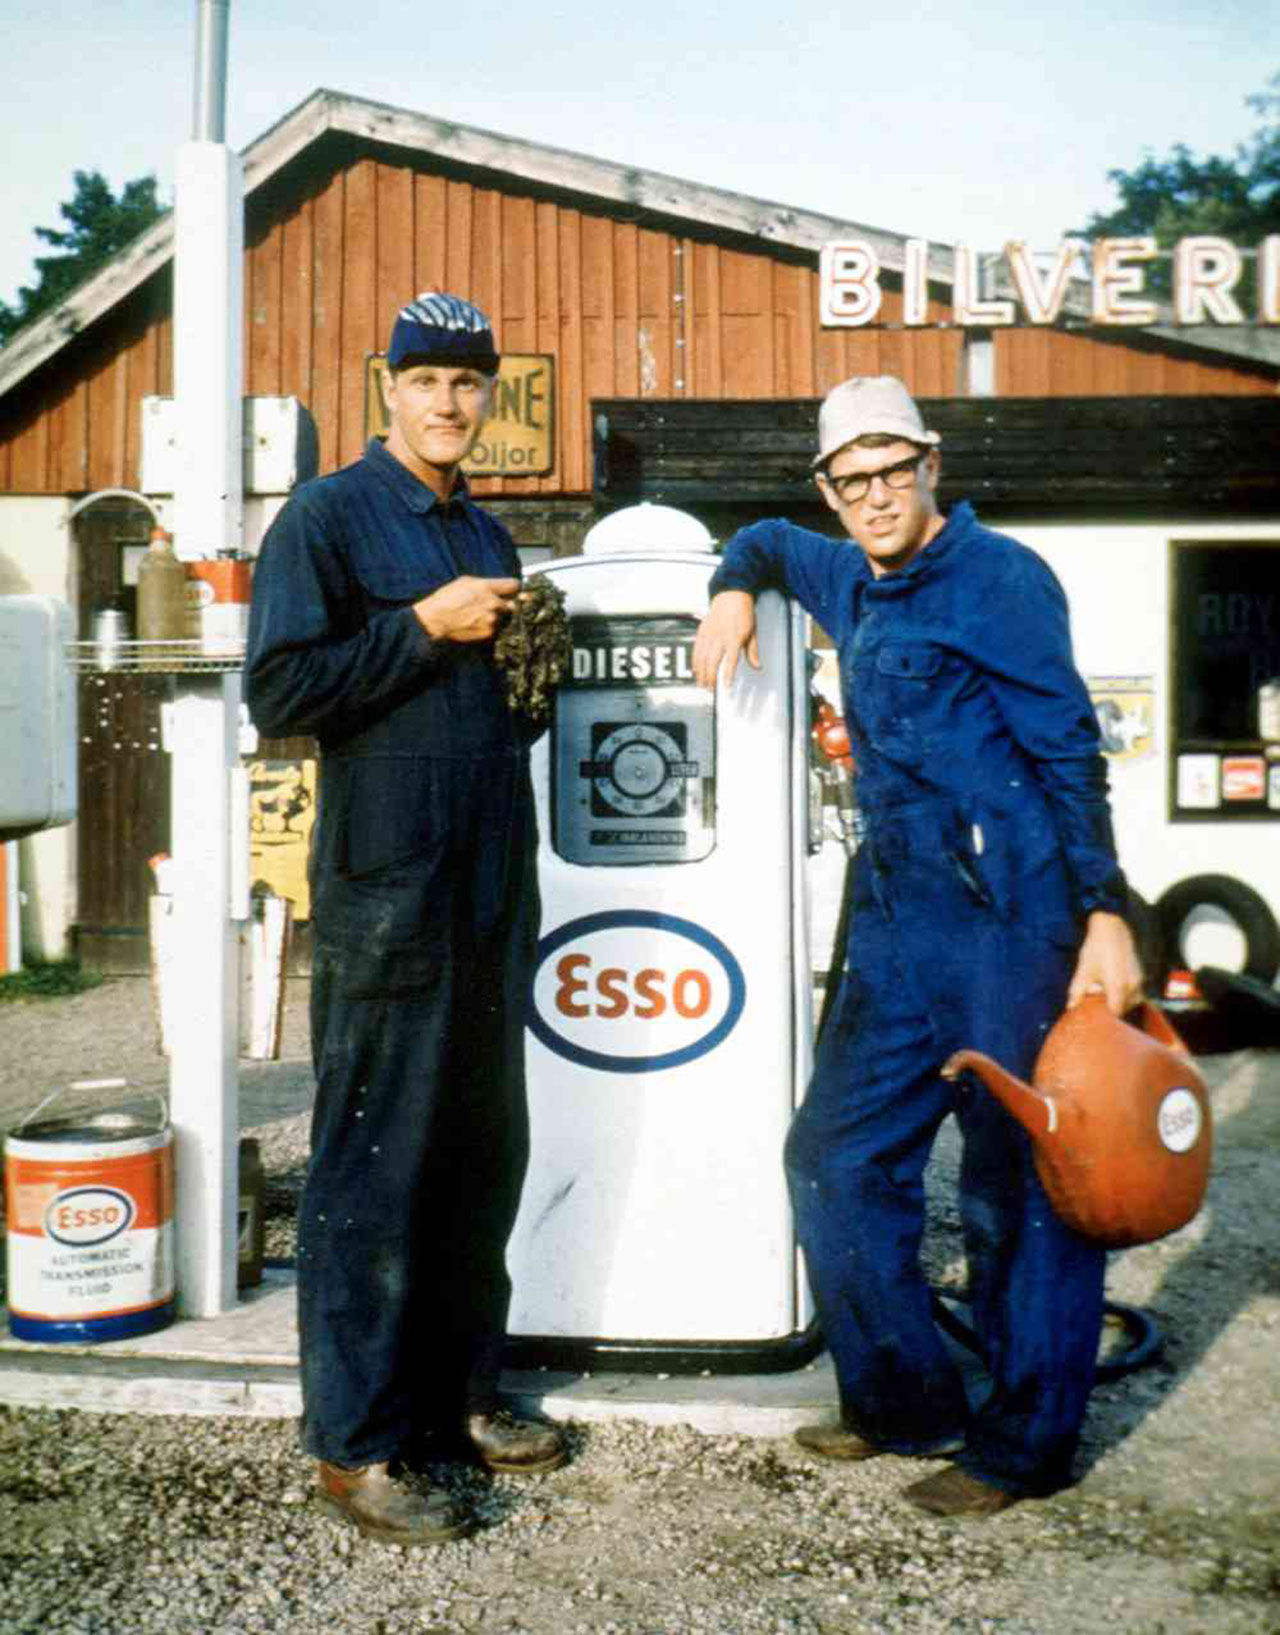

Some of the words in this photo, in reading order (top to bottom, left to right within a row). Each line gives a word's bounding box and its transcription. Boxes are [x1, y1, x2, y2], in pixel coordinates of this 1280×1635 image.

[573, 646, 693, 679] DIESEL
[51, 1247, 131, 1266] AUTOMATIC
[68, 1281, 113, 1298] FLUID
